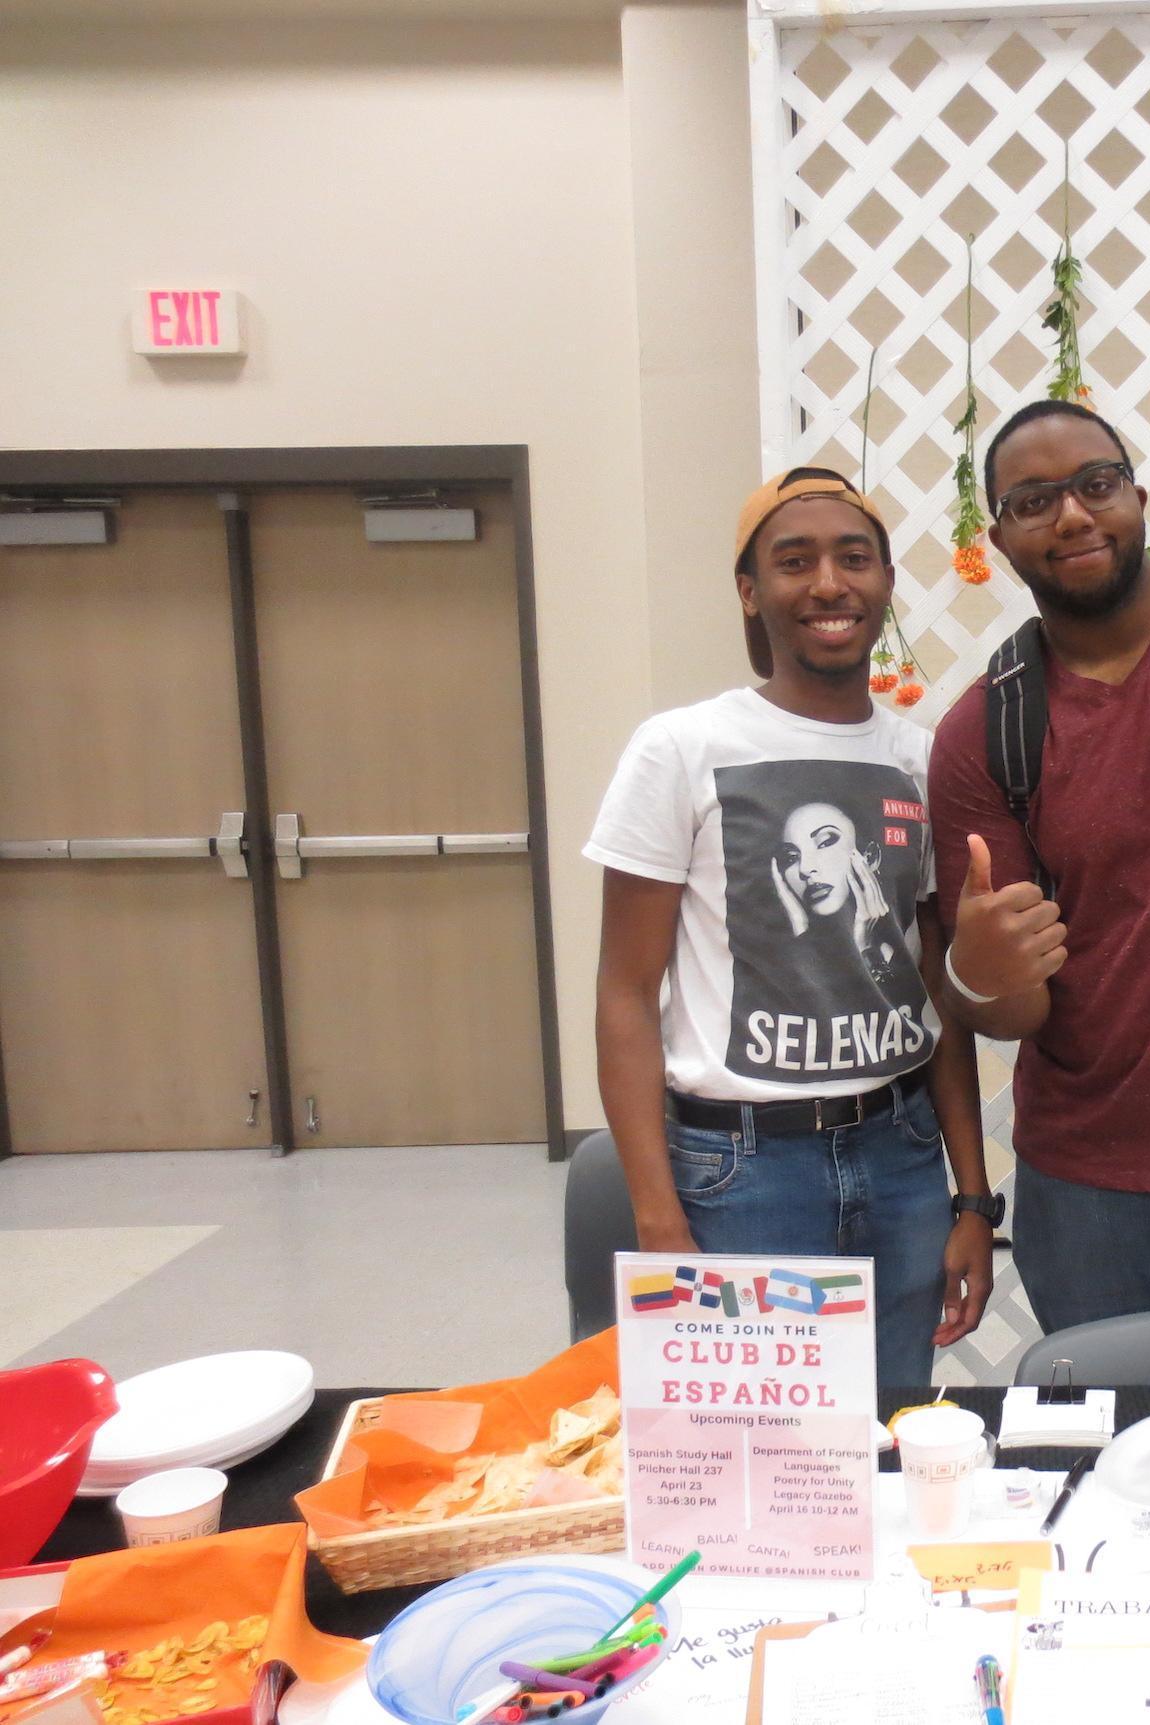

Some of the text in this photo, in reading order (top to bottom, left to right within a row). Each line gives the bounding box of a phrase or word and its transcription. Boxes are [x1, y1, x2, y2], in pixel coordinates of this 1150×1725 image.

[150, 292, 221, 346] EXIT
[886, 829, 907, 843] FOR
[746, 1004, 925, 1071] SELENAS
[675, 1323, 818, 1337] COME JOIN THE
[662, 1340, 821, 1367] CLUB DE
[661, 1377, 836, 1408] ESPAÑOL
[690, 1413, 802, 1428] Upcoming Events
[628, 1448, 732, 1462] Spanish Study Hall
[752, 1446, 869, 1461] Department of Foreign
[638, 1464, 723, 1476] Pilcher Hall 237
[784, 1462, 841, 1475] Languages
[660, 1481, 702, 1493] April 23
[774, 1476, 855, 1489] Poetry for Unity
[646, 1495, 717, 1507] 5:30-6:30 PM
[774, 1490, 853, 1502] Legacy Gazebo
[769, 1505, 859, 1517] April 16 10-12 AM
[641, 1533, 862, 1559] LEARN! BAILA! CANTA! SPEAK!
[709, 1564, 761, 1575] OWLLIFE
[765, 1565, 826, 1577] @SPANISH
[830, 1567, 861, 1578] CLUB
[691, 1654, 718, 1670] la
